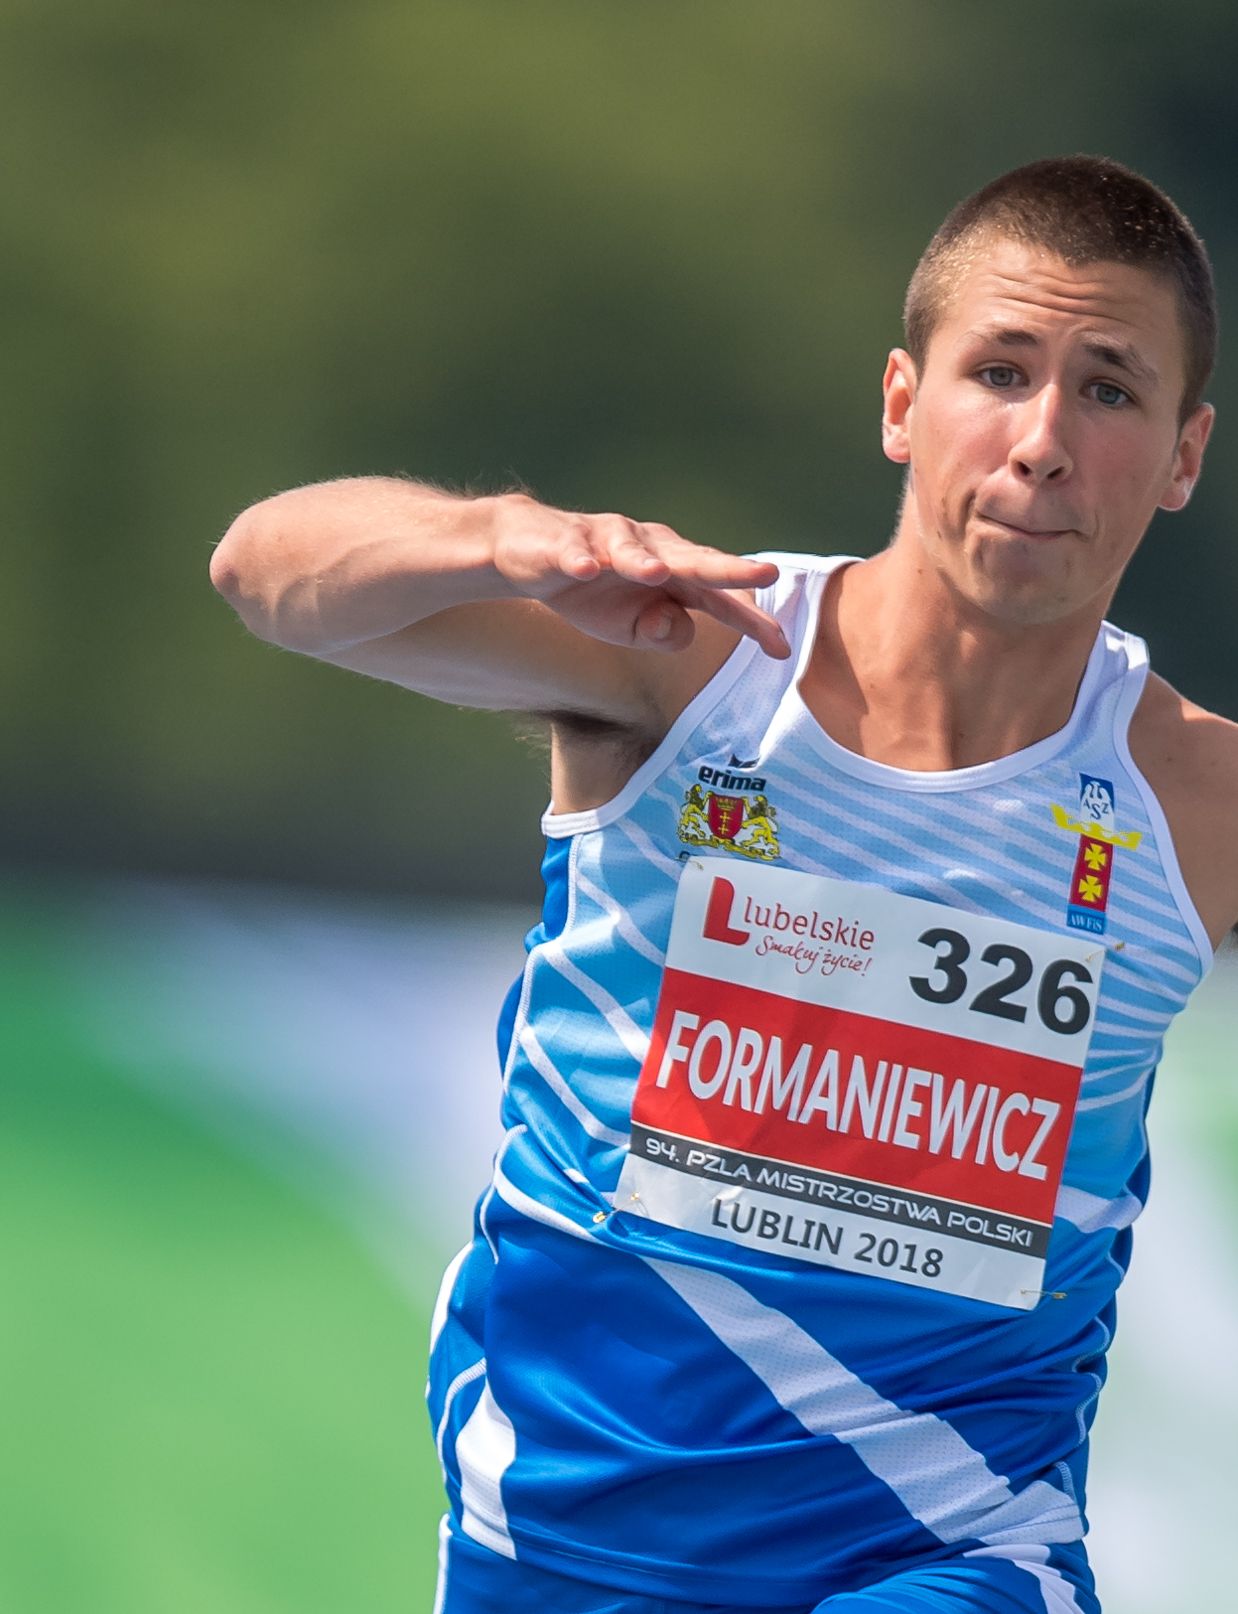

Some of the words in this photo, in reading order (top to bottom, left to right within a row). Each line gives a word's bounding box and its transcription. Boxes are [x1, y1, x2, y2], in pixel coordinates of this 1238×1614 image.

[698, 765, 767, 792] erima
[755, 935, 823, 974] Smakuj
[821, 949, 873, 977] życie!
[908, 928, 1094, 1035] 326
[656, 1009, 1061, 1181] FORMANIEWICZ
[645, 1137, 680, 1163] 94.
[686, 1149, 752, 1182] PZLA
[756, 1168, 942, 1225] MISTRZOSTWA
[947, 1211, 1034, 1247] POLSKI
[711, 1198, 844, 1255] LUBLIN
[853, 1232, 944, 1278] 2018
